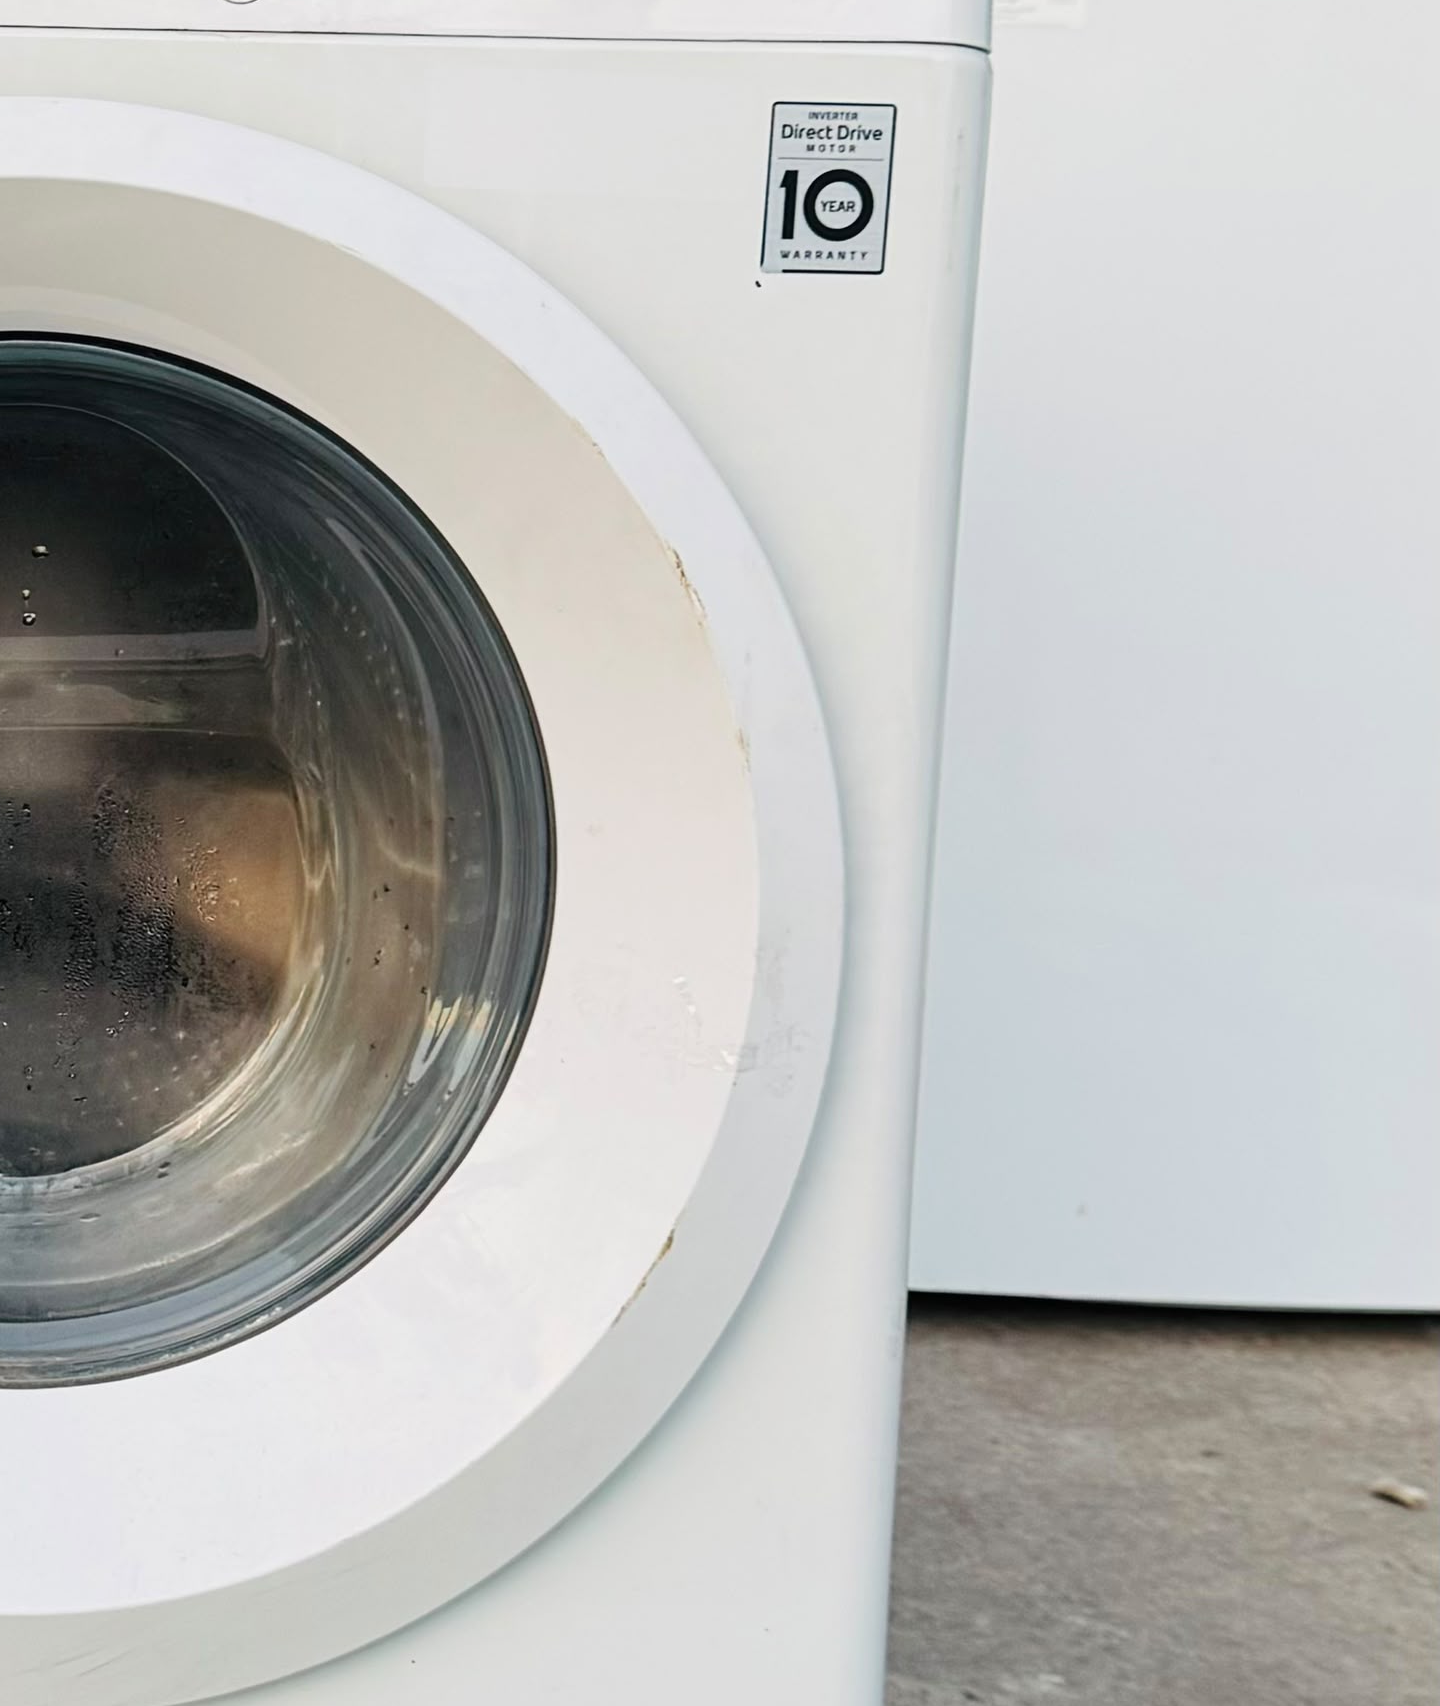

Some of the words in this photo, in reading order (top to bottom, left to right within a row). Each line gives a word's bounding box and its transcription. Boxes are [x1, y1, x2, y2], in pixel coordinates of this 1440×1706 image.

[808, 111, 858, 121] INVERTER
[781, 123, 833, 140] Direct
[836, 124, 883, 141] Drive
[806, 144, 857, 153] MOTOR
[779, 168, 874, 242] 10
[820, 200, 856, 212] YEAR
[780, 250, 869, 261] WARRANTY
